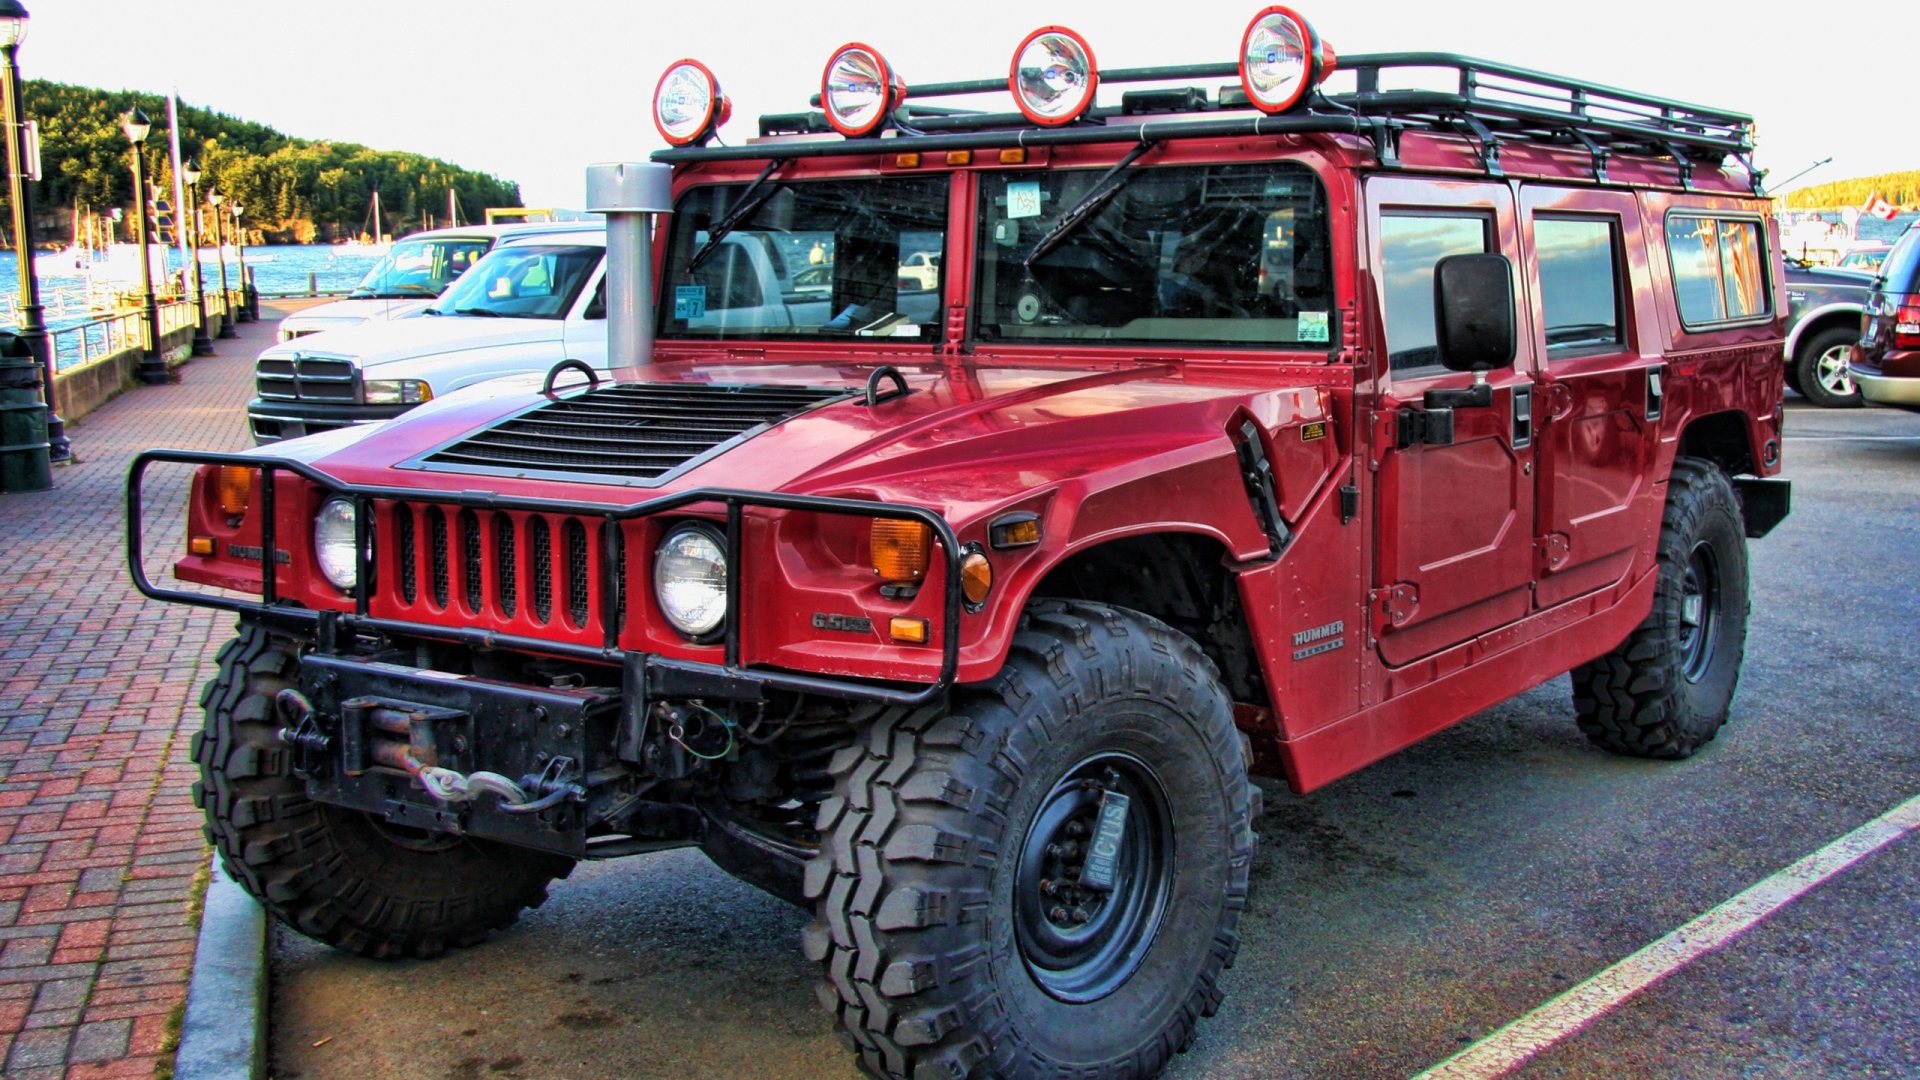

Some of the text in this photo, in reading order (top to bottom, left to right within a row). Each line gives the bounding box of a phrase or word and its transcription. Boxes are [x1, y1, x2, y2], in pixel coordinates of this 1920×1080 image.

[693, 302, 699, 316] 7
[1293, 620, 1344, 646] HUMMER
[1094, 805, 1125, 857] CTIS
